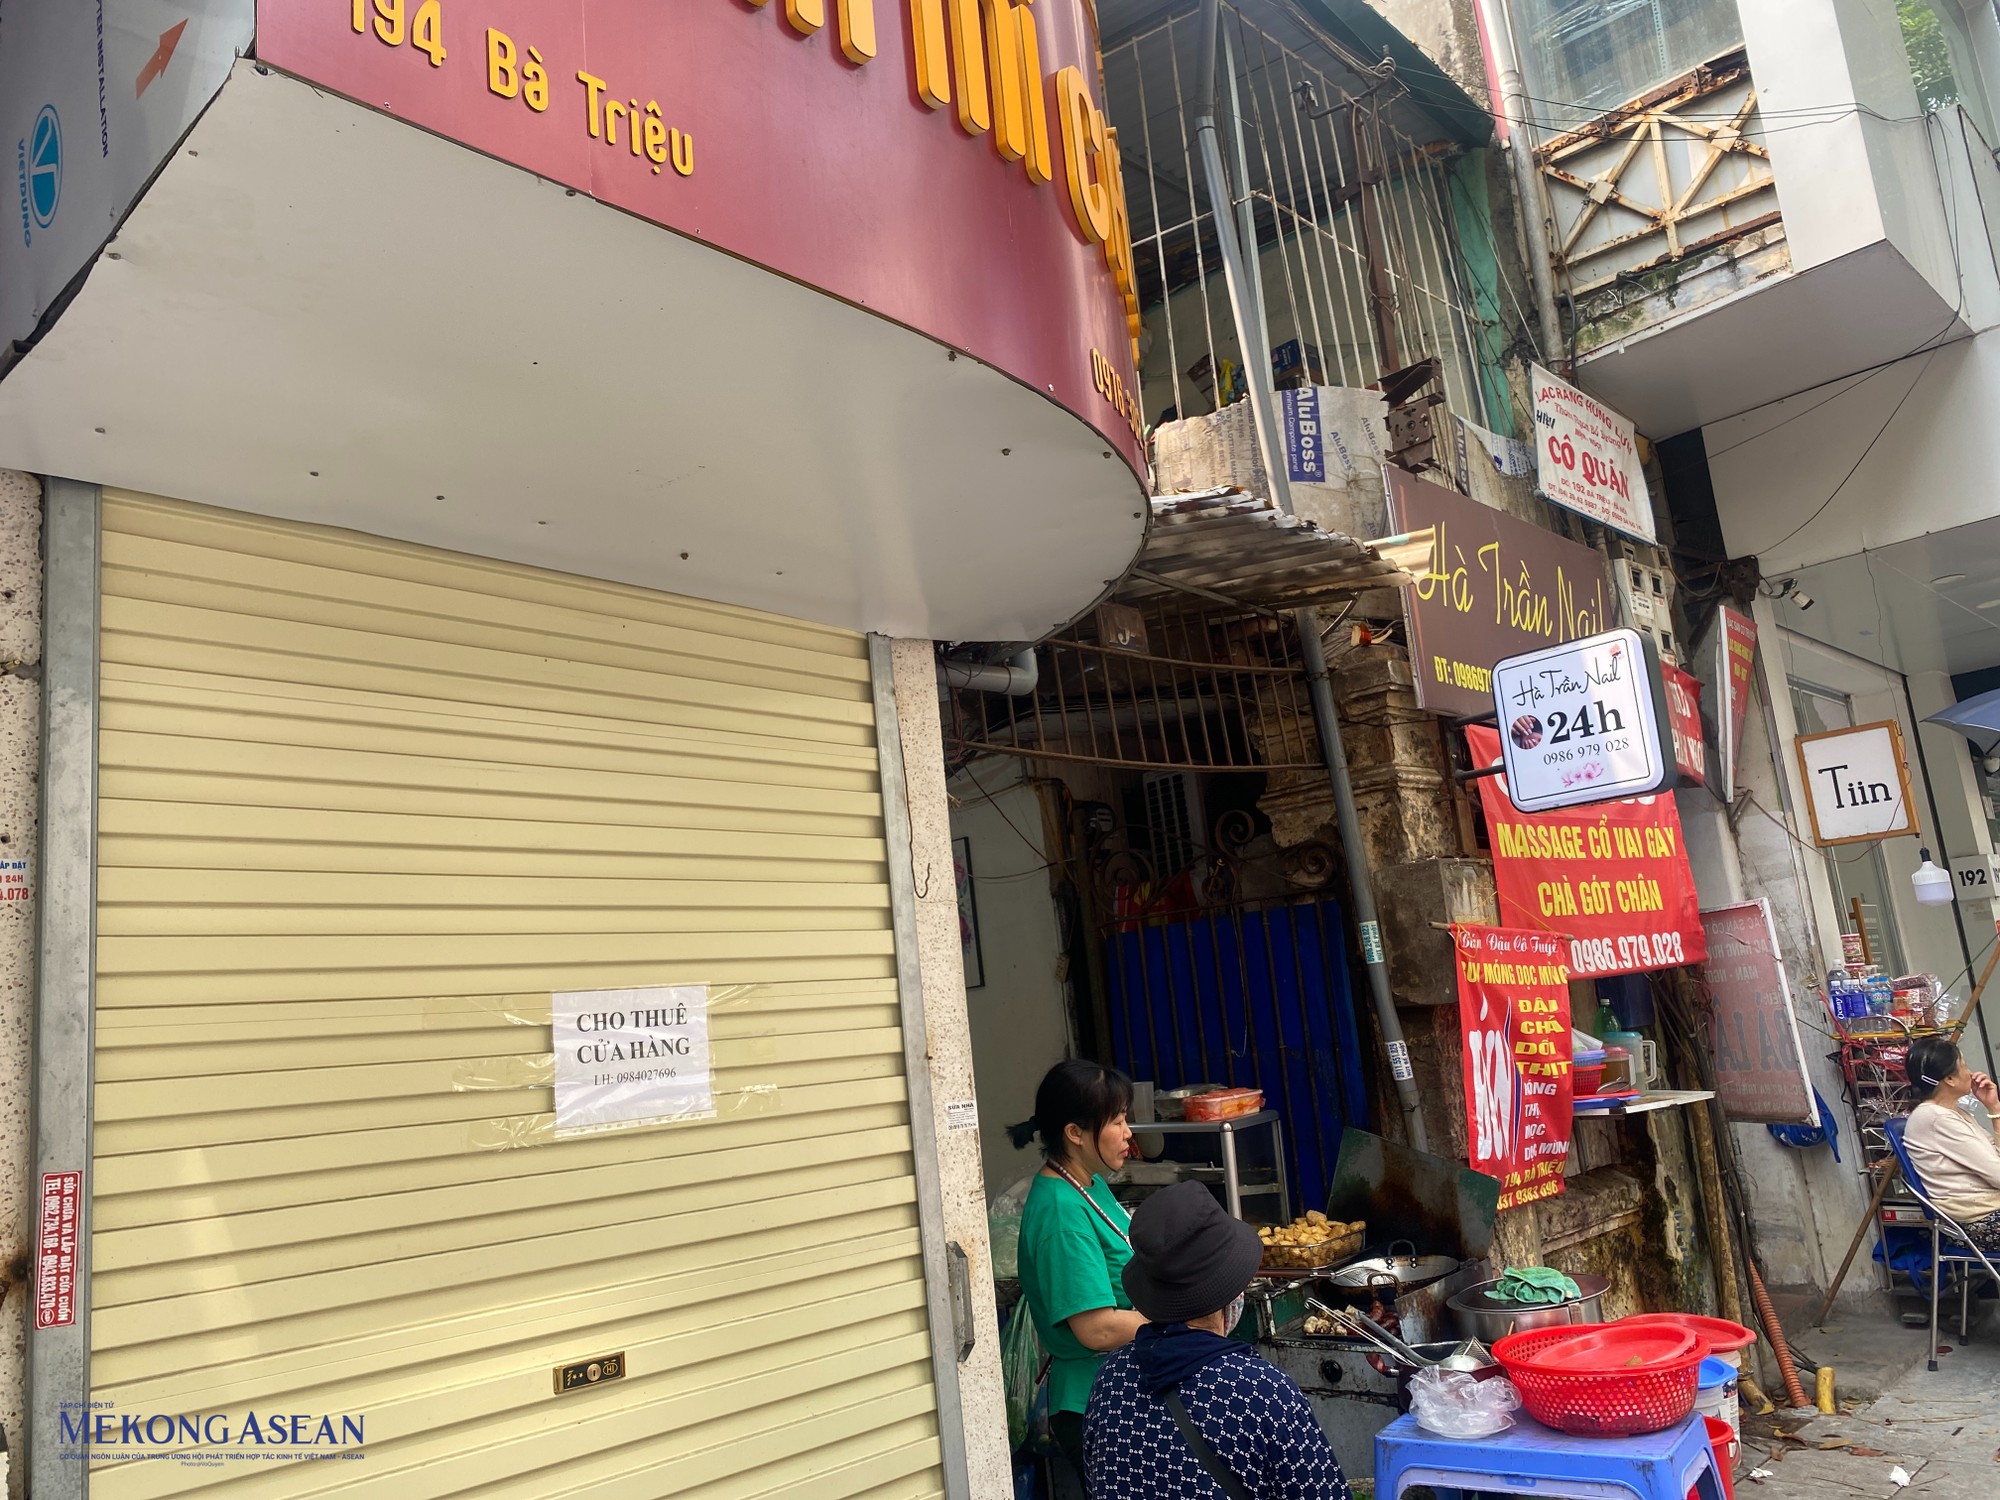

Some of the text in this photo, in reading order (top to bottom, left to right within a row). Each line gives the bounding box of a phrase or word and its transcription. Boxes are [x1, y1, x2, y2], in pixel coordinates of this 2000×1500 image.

[97, 38, 109, 159] INSTALLATION
[487, 27, 549, 112] Bà
[577, 70, 695, 176] Triệu
[17, 138, 32, 249] VIETDUNG
[1555, 387, 1584, 407] RANG
[1297, 387, 1317, 473] AluBoss
[1330, 431, 1353, 471] AluBoss
[1548, 433, 1576, 471] CÔ
[1416, 521, 1605, 643] Hà Trần Nail
[1434, 656, 1453, 685] ĐT:
[1512, 656, 1621, 709] Hà Trần Nail
[1547, 699, 1626, 745] 24h
[1543, 737, 1629, 765] 0986 979 028
[1818, 764, 1893, 809] Tiin
[1496, 813, 1676, 859] MASSAGE CỔ VAI GÁY
[5, 874, 24, 883] 24H
[1958, 868, 1987, 886] 192
[1537, 873, 1664, 917] CHÀ GÓT CHÂN
[1486, 932, 1511, 955] Đậu
[1513, 934, 1528, 952] Cô
[1571, 931, 1686, 974] 0986.979.028
[1483, 958, 1516, 985] MÓNG
[1515, 964, 1538, 990] DỌC
[576, 1002, 688, 1033] CHO THUÊ
[1520, 1015, 1565, 1035] CHẢ
[577, 1035, 691, 1064] CỬA HÀNG
[594, 1067, 677, 1086] LH: 0984027696
[1516, 1061, 1572, 1078] THỊT
[1536, 1158, 1566, 1178] TRIỆU
[45, 1178, 61, 1195] TEL:
[63, 1176, 77, 1195] SỬA
[1515, 1185, 1539, 1205] 9383
[61, 1237, 75, 1254] LẮP
[58, 1256, 73, 1273] ĐẶT
[59, 1275, 73, 1295] CỬA
[57, 1295, 71, 1322] CUỐN
